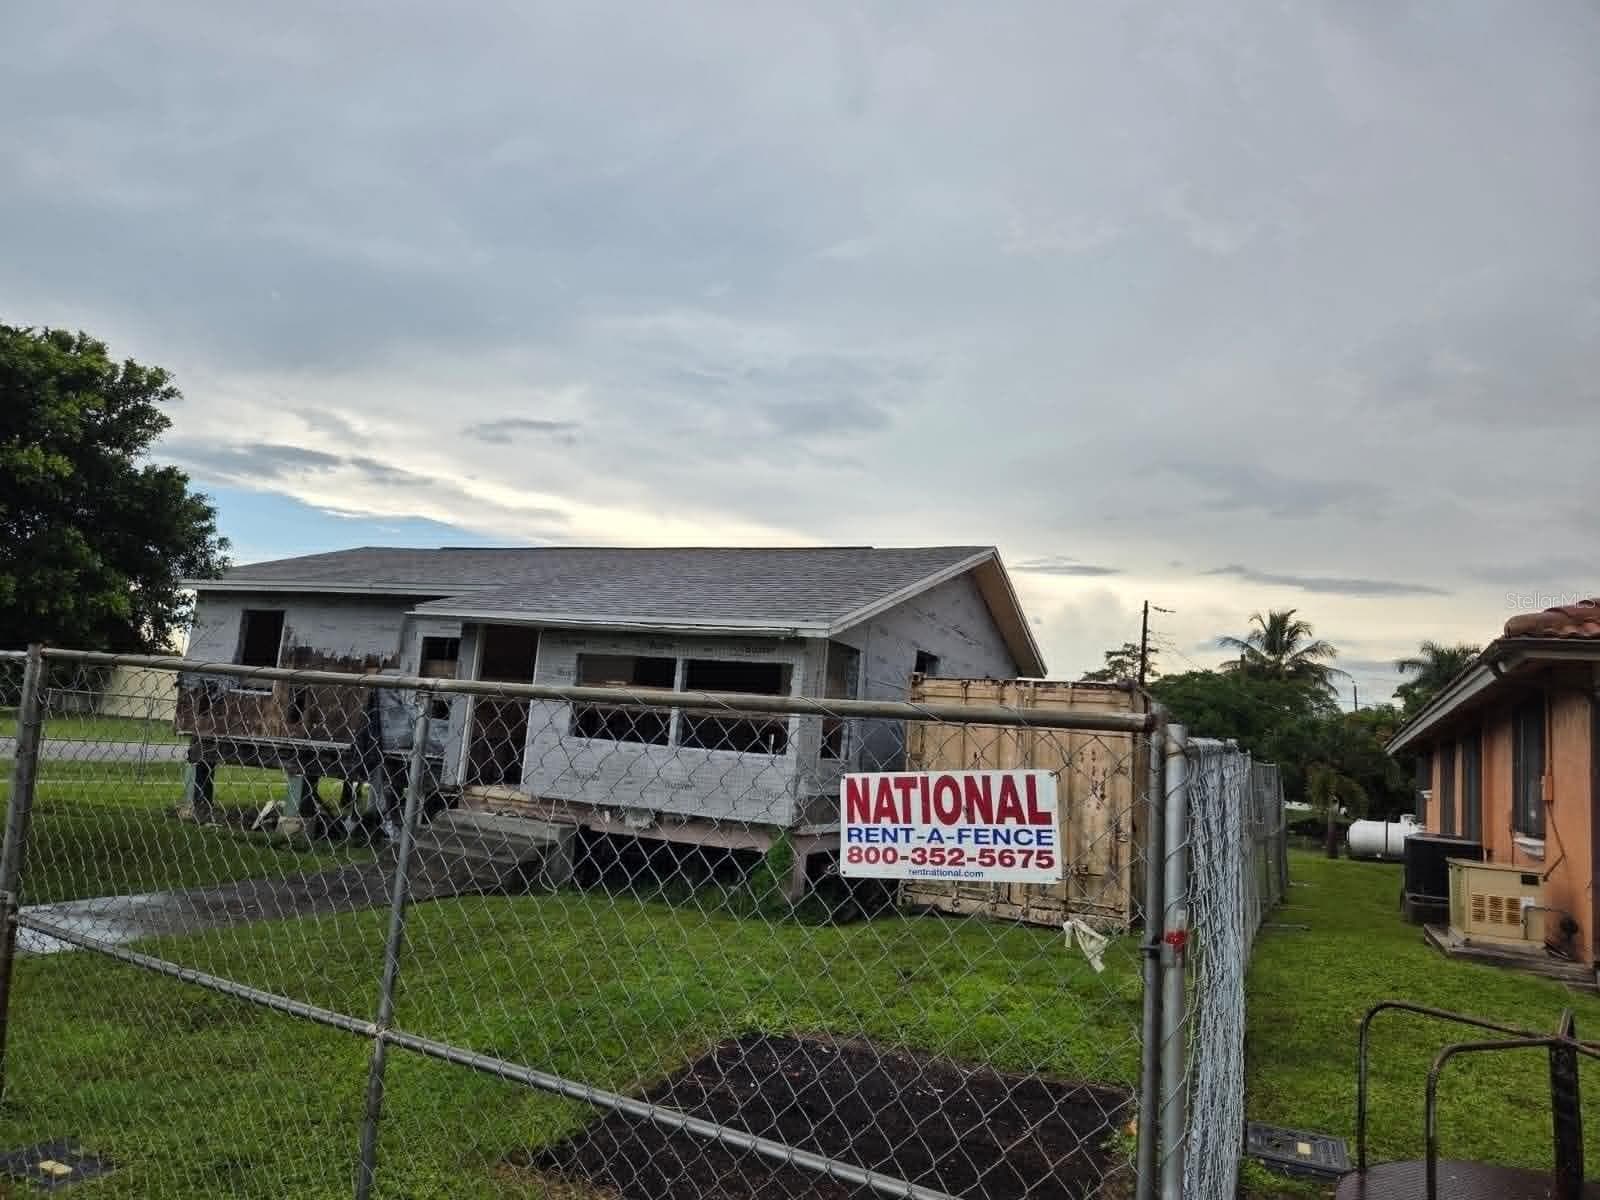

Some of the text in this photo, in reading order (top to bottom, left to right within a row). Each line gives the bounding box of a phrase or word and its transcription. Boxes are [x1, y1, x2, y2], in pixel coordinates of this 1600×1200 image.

[846, 774, 1053, 825] NATIONAL
[847, 827, 1054, 846] RENT-A-FENCE
[847, 846, 1055, 869] 800-352-5675
[908, 868, 984, 878] rentnational.com
